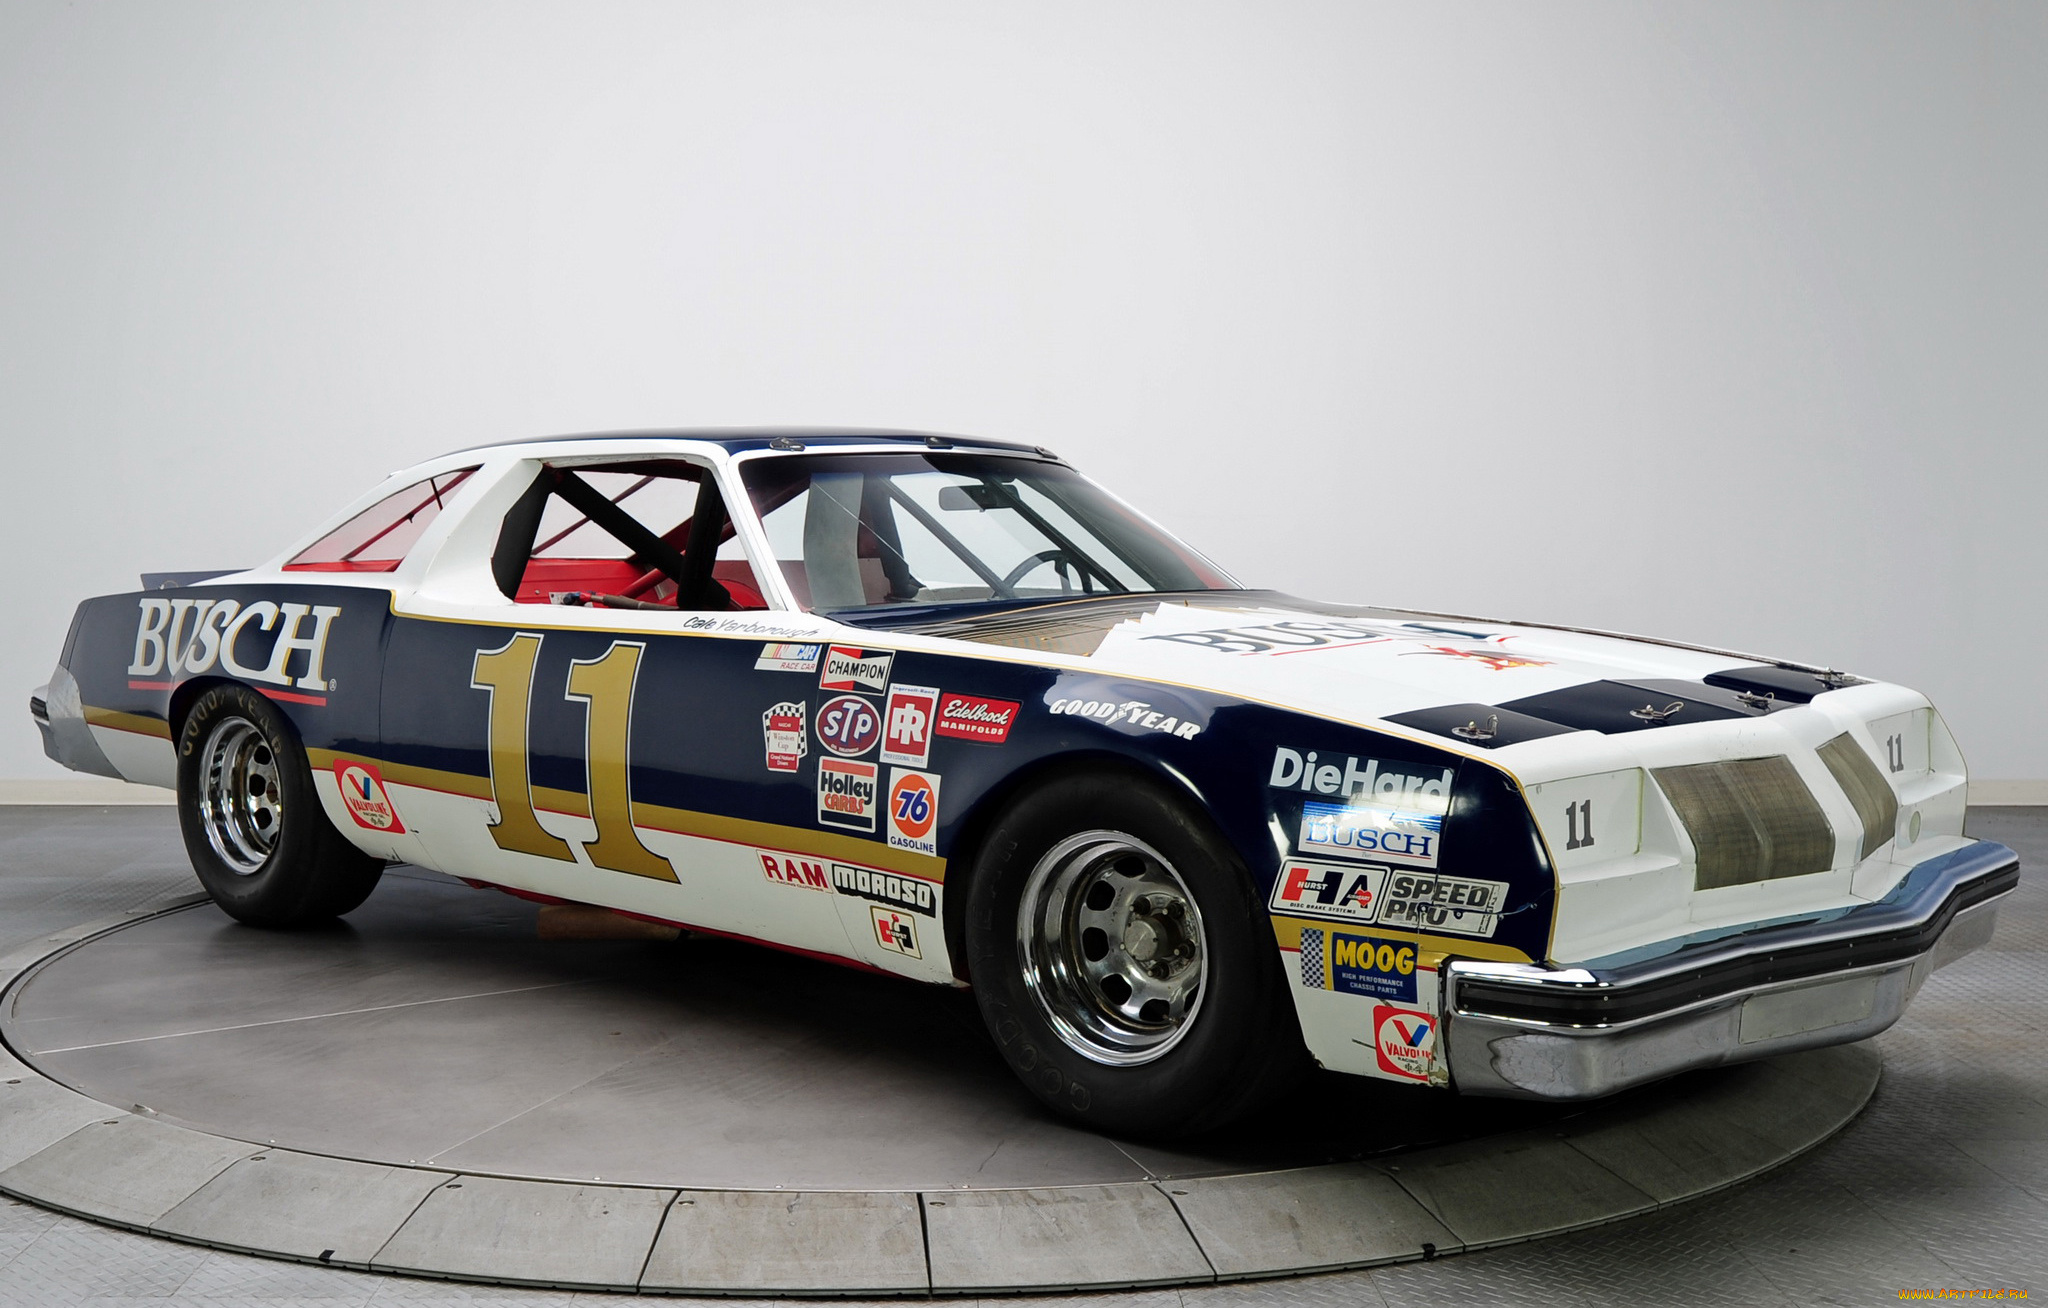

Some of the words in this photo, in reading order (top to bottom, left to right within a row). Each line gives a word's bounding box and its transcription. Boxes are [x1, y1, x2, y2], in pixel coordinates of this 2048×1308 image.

[683, 616, 717, 630] Cale
[716, 619, 820, 638] Yarborough
[128, 598, 341, 691] BUSCH
[780, 662, 800, 670] RACE
[801, 663, 817, 671] CAR
[828, 660, 885, 679] CHAMPION
[824, 701, 873, 743] STP
[944, 699, 1012, 725] Edelbrock
[941, 721, 1004, 735] MANIFOLDS
[470, 631, 682, 884] 11
[1886, 733, 1905, 774] 11
[820, 771, 874, 806] Holley
[1270, 747, 1453, 806] DieHard
[349, 796, 390, 817] VALVOLINE
[825, 793, 865, 815] CARBS
[897, 788, 929, 823] 76
[1306, 821, 1433, 857] BUSCH
[1565, 799, 1594, 851] 11
[890, 836, 934, 854] GASOLINE
[761, 854, 828, 889] RAM
[833, 865, 931, 909] MOROSO
[1297, 881, 1328, 890] HURST
[1391, 876, 1490, 907] SPEED
[1328, 906, 1356, 914] SYSTEMS
[1335, 939, 1415, 976] MOOG
[1341, 972, 1357, 980] HIGH
[1358, 974, 1404, 988] PERFORMANCE
[1349, 981, 1376, 992] CHASSIS
[1377, 986, 1397, 995] PARTS
